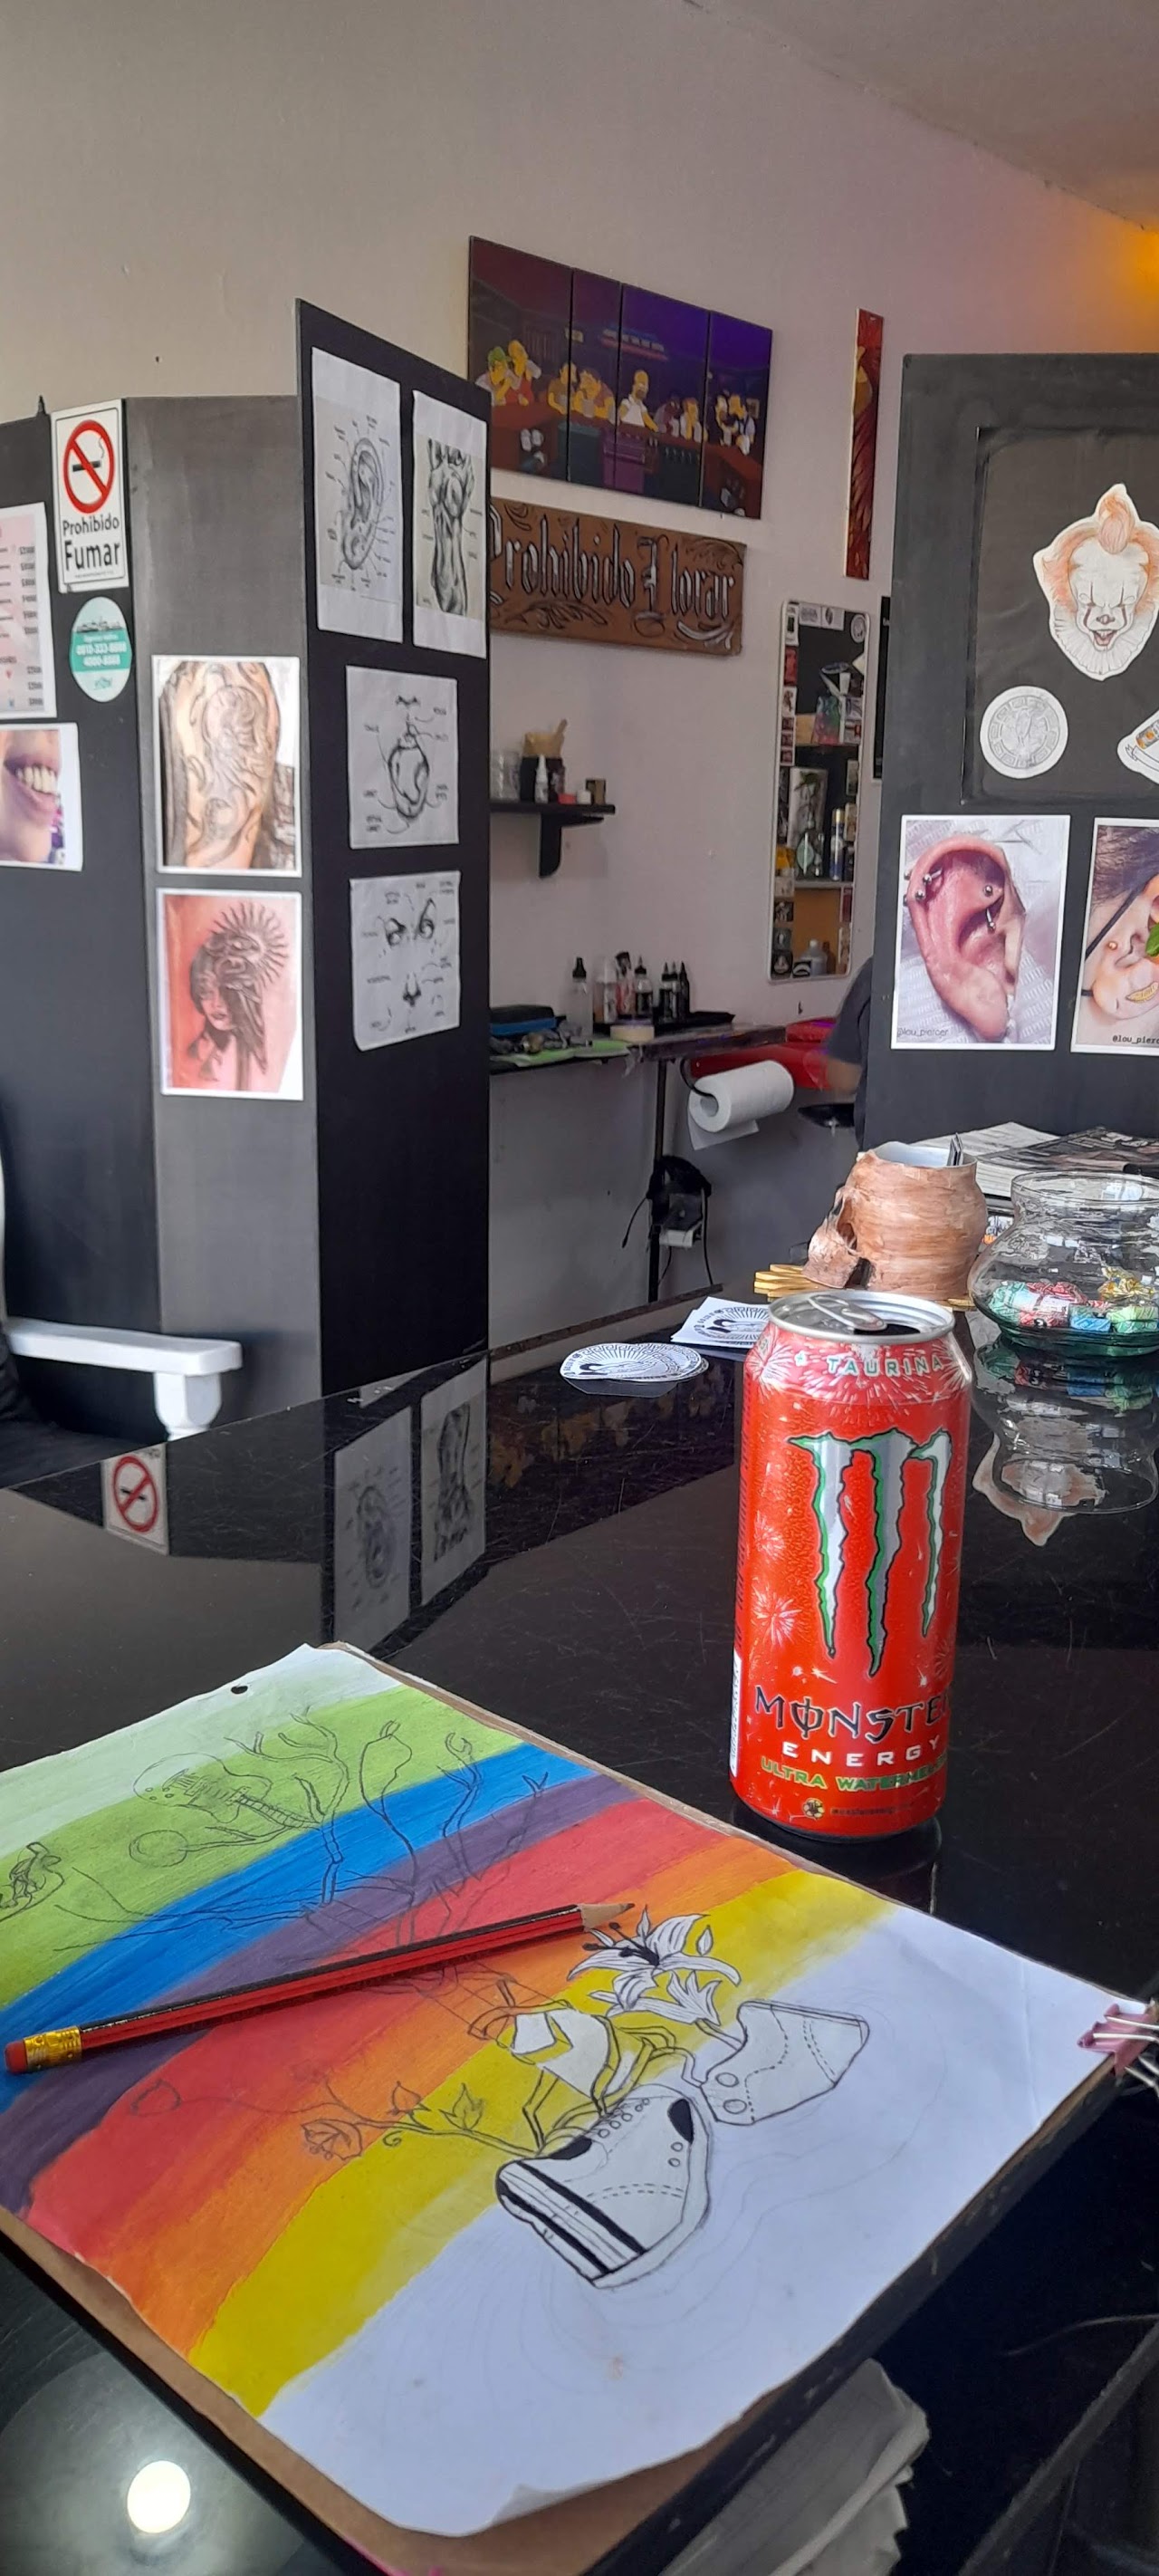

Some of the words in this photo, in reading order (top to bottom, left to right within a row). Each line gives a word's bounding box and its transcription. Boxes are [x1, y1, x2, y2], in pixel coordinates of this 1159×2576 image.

[62, 513, 120, 536] Prohibido
[64, 540, 120, 571] Fumar
[827, 1354, 945, 1377] TAURINA
[782, 1735, 940, 1766] ENERGY
[761, 1755, 828, 1790] ULTRA
